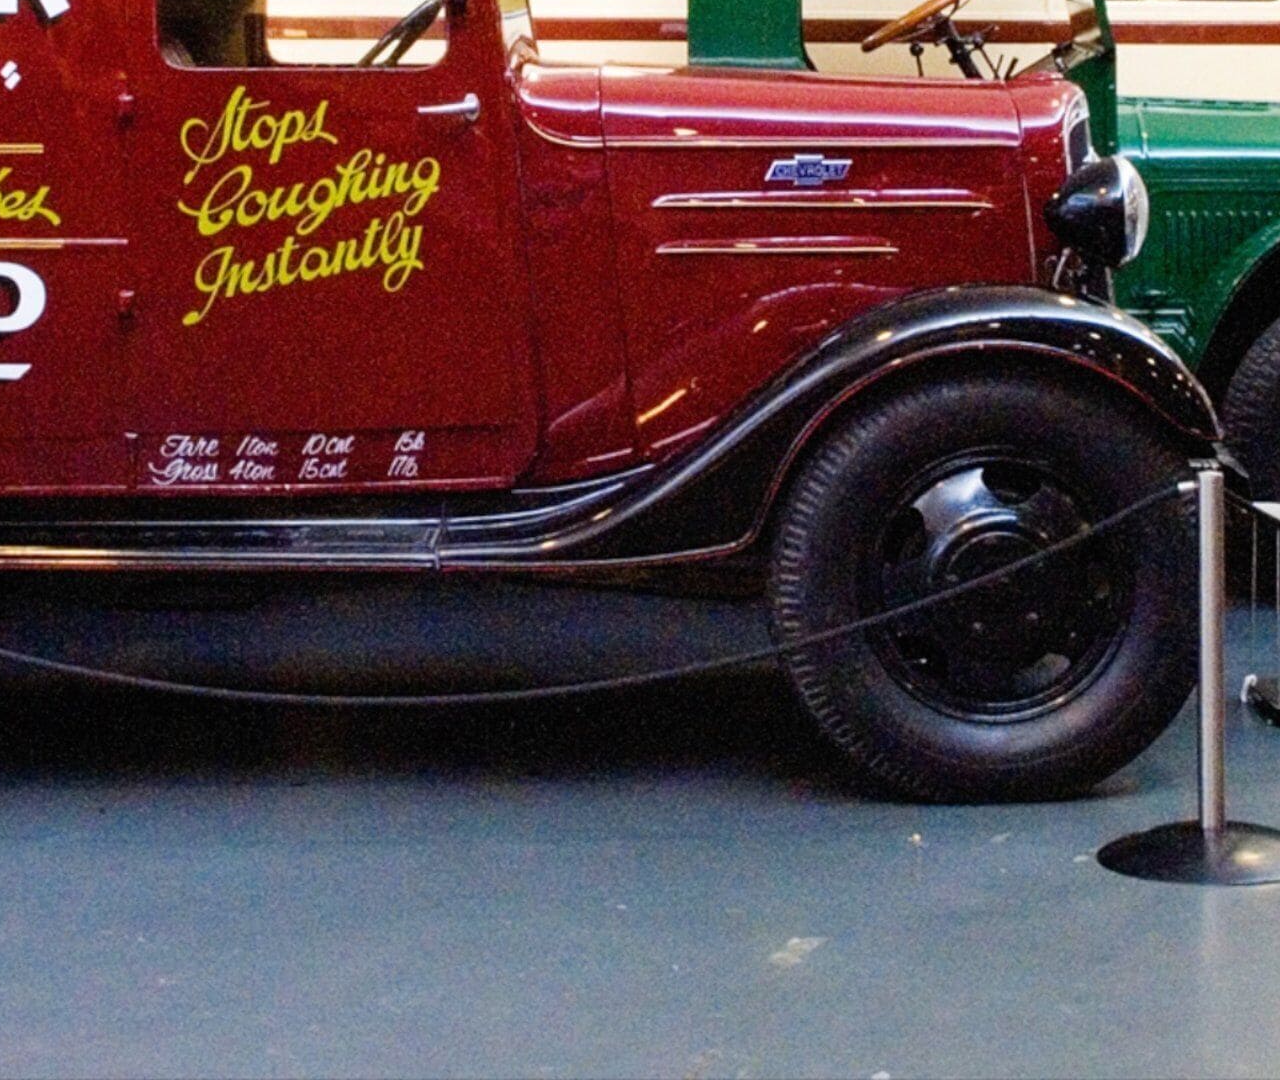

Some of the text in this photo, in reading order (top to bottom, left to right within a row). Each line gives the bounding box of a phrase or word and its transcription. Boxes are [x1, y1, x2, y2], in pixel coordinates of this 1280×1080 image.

[181, 86, 338, 183] Stops
[178, 149, 441, 236] Coughing
[774, 164, 844, 177] CHEVROLET
[182, 213, 424, 326] Instantly
[148, 460, 220, 486] Gross
[160, 434, 220, 457] Tare
